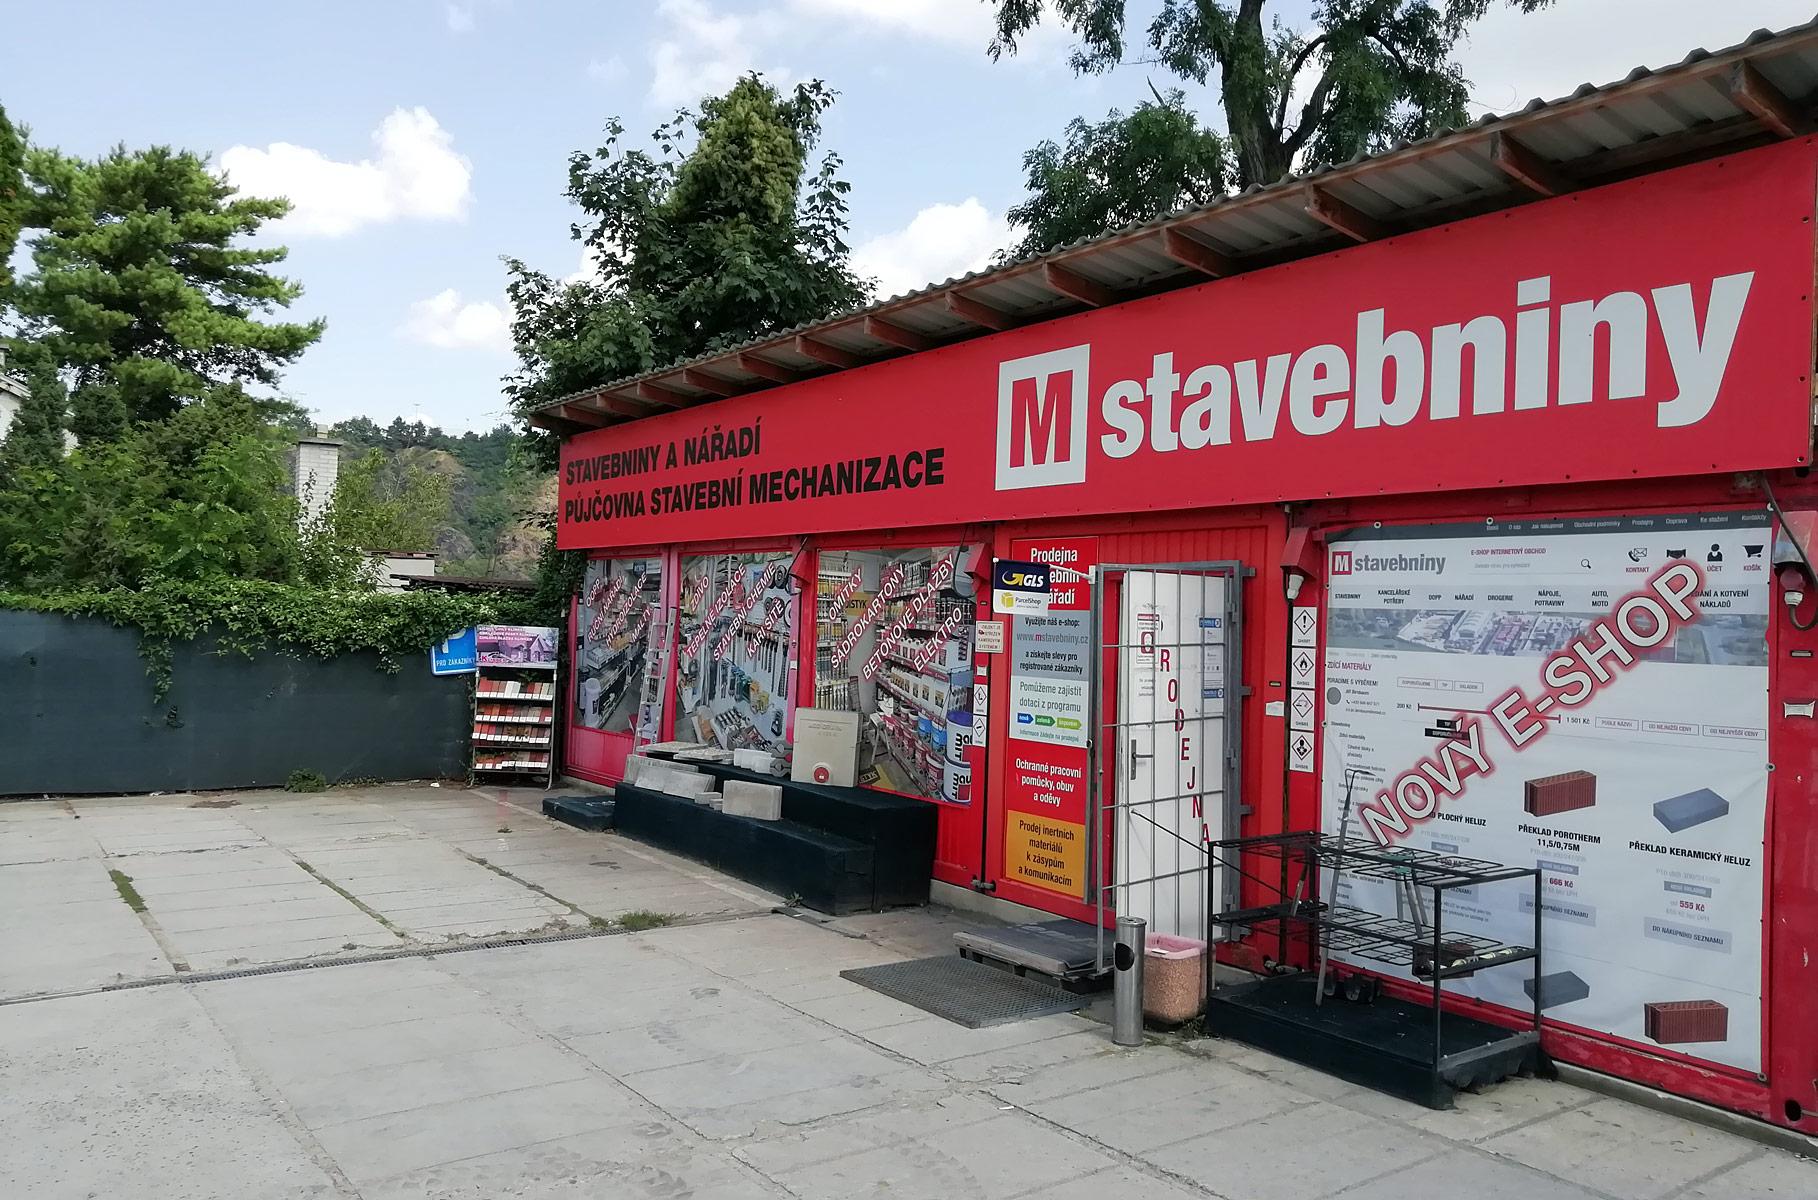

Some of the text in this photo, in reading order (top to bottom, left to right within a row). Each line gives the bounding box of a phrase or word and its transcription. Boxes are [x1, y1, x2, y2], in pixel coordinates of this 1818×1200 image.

[1004, 270, 1755, 472] M stavebniny
[566, 415, 761, 486] STAVEBNINY A NÁŘADÍ
[565, 448, 945, 524] PŮJČOVNA STAVEBNÍ MECHANIZACE
[1030, 547, 1078, 565] Prodejna
[1490, 547, 1523, 555] INTERNETOVÝ
[1334, 552, 1446, 574] M stavebniny
[1707, 564, 1722, 572] ÚČET
[715, 563, 746, 613] IZOLACE
[746, 562, 776, 609] CHEMIE
[1023, 574, 1044, 588] GLS
[691, 576, 709, 612] ZDIVO
[829, 567, 863, 621] OMÍTKY
[1377, 588, 1411, 596] KANCELÁŘSKÉ
[1454, 593, 1474, 601] NÁŘADÍ
[1591, 590, 1609, 598] AUTO,
[1720, 589, 1749, 597] KOTVENÍ
[1015, 597, 1042, 605] ParcelShop
[1383, 597, 1404, 605] POTŘEBY
[1700, 599, 1731, 608] NÁKLADŮ
[605, 571, 647, 649] HYDROIZOLACE
[830, 564, 905, 669] SÁDROKARTONY
[862, 553, 955, 680] BETONOVÉ DLAŽBY
[1024, 616, 1080, 627] Využijte náš e-shop:
[747, 626, 766, 658] KARI
[913, 607, 962, 671] ELEKTRO
[1016, 633, 1089, 646] www.mstavebniny.cz
[436, 658, 447, 667] PRO
[1030, 650, 1051, 660] získejte
[1052, 651, 1067, 661] slevy
[1067, 653, 1078, 661] pro
[1019, 661, 1083, 674] registrované zákazníky
[1341, 661, 1372, 671] MATERIÁLY
[1020, 681, 1082, 697] Pomůžeme zajistit
[1019, 697, 1081, 712] dotaci z programu
[1361, 563, 1700, 847] NOVÝ E-SHOP
[1582, 717, 1590, 725] Kč
[1015, 757, 1082, 779] Ochranné pracovní
[1021, 774, 1075, 792] pomůcky, obuv
[1033, 791, 1061, 807] a oděvy
[1437, 812, 1463, 823] PLOCHÝ
[1464, 816, 1487, 827] HELUZ
[1019, 819, 1075, 841] Prodej inertních
[1518, 823, 1601, 844] PŘEKLAD POROTHERM
[1029, 838, 1063, 854] materiálů
[1537, 838, 1580, 852] 11,5/0,75M
[1026, 850, 1065, 870] k zásypům
[1629, 840, 1751, 867] PŘEKLAD KERAMICKÝ HELUZ
[1018, 864, 1072, 886] a komunikacím
[1564, 879, 1574, 889] Kč
[1563, 908, 1589, 919] SEZNAMU
[1679, 900, 1694, 910] 555
[1695, 903, 1705, 912] Kč
[1661, 926, 1692, 940] NÁKUPNÍHO
[1693, 934, 1724, 945] SEZNAMU
